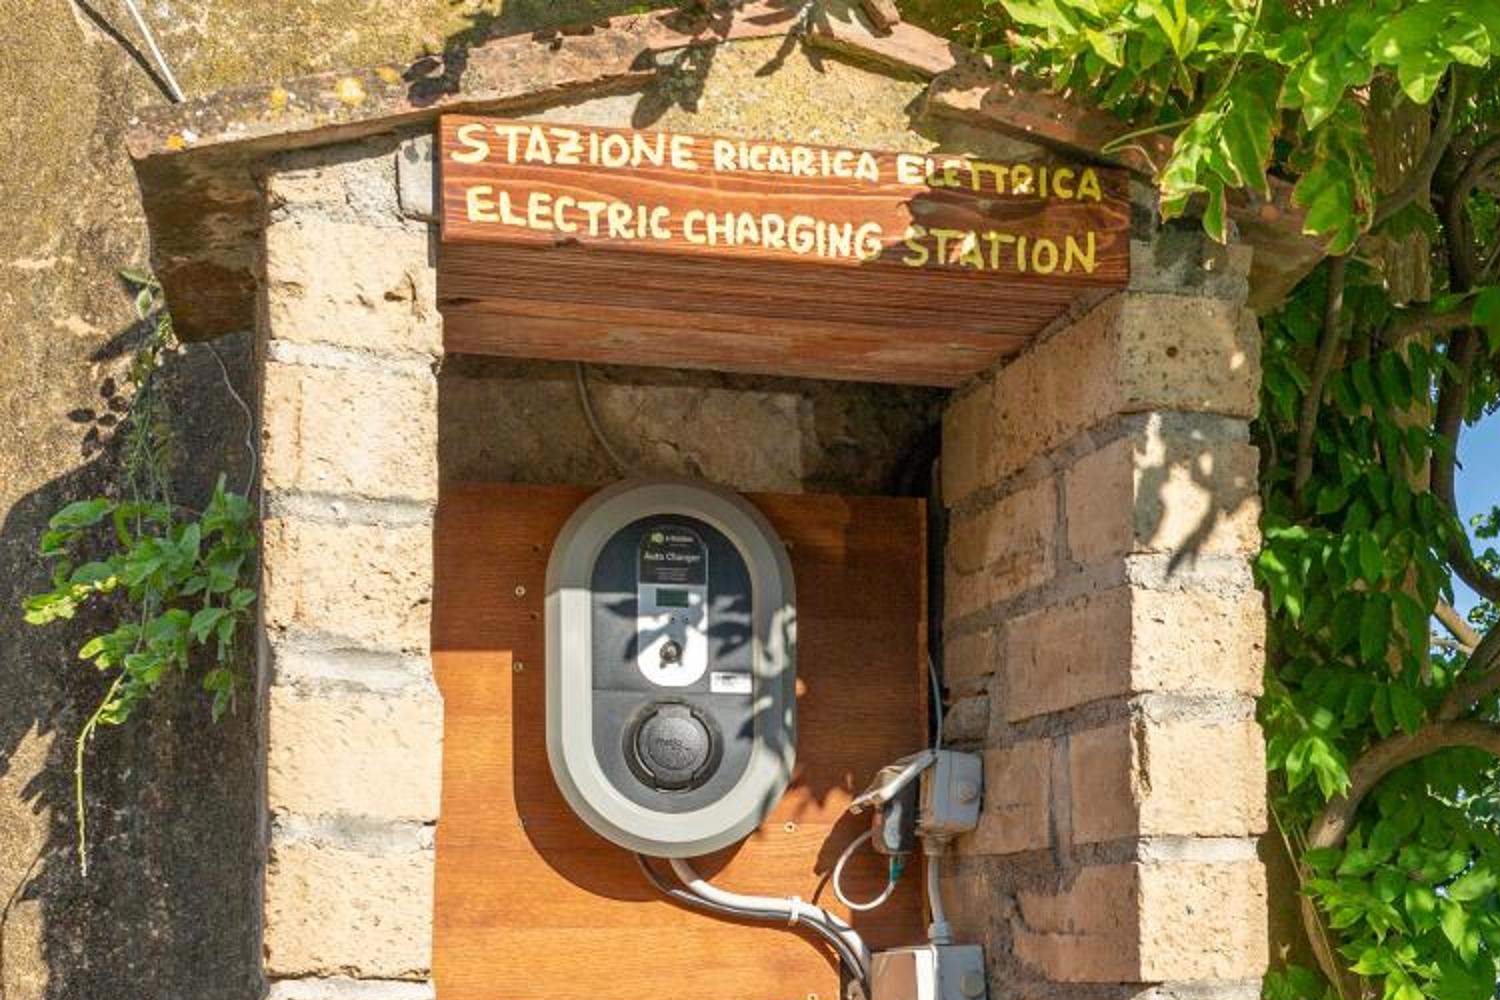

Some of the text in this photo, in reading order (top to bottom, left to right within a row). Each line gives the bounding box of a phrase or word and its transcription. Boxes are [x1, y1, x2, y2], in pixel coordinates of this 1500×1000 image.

[450, 123, 1102, 201] STAZIONE RICARICA ELETTRICA
[465, 185, 1100, 274] ELECTRIC CHARGING STATION
